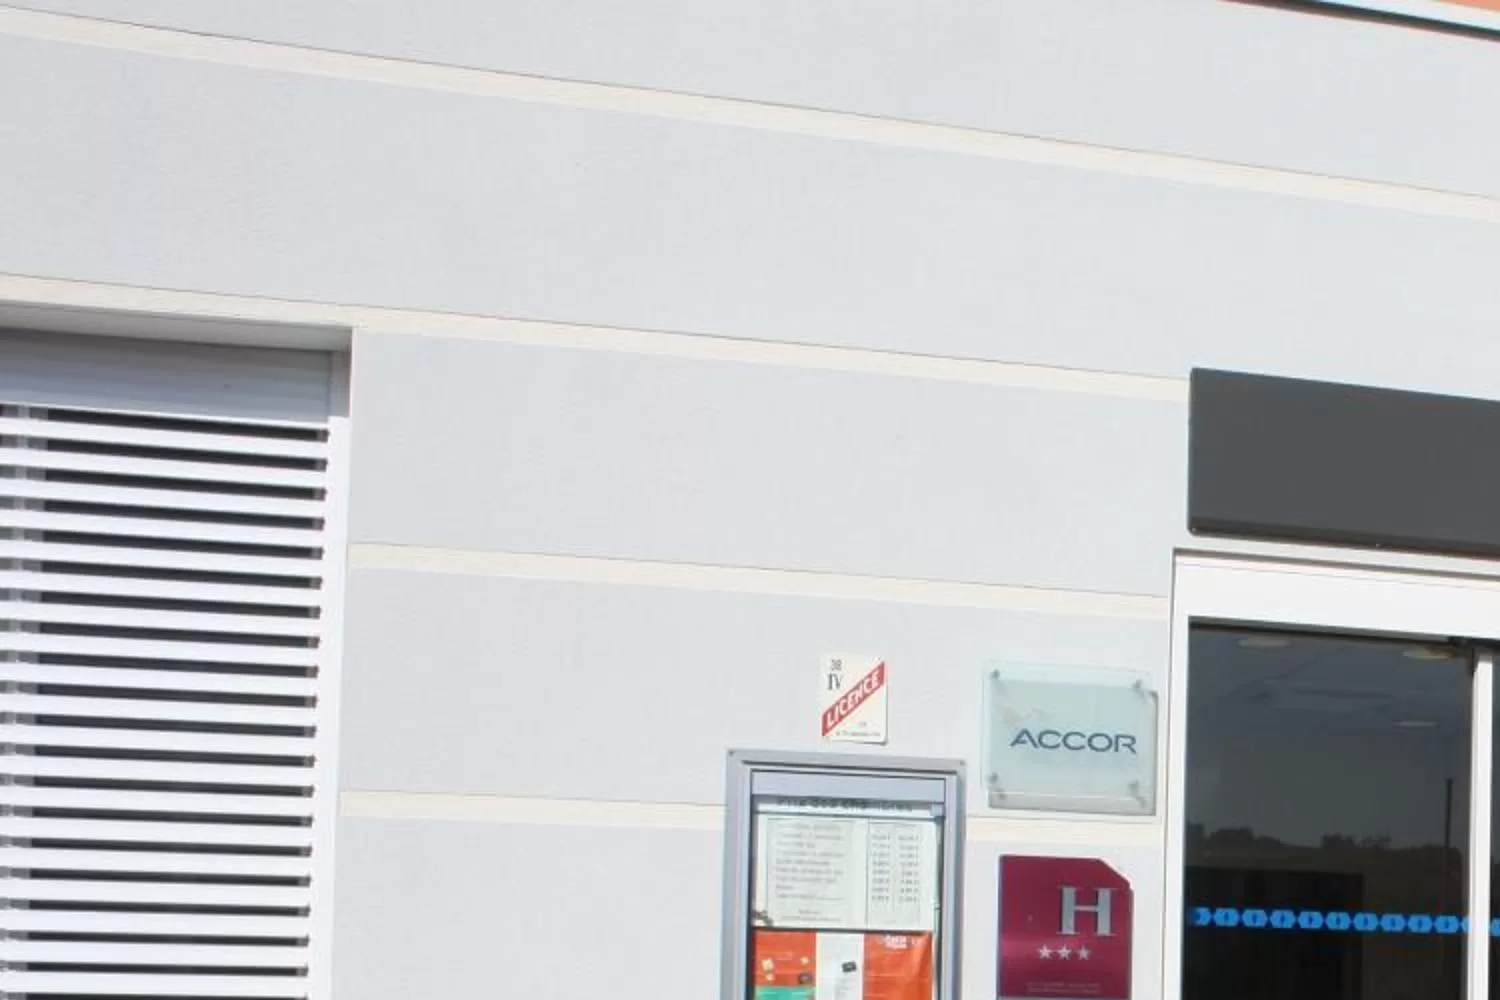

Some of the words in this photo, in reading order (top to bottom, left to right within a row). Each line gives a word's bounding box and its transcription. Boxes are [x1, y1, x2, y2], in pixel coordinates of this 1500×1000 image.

[826, 669, 880, 728] LICENCE
[828, 673, 845, 690] IV
[1009, 727, 1138, 754] ACCOR
[1056, 885, 1118, 937] H
